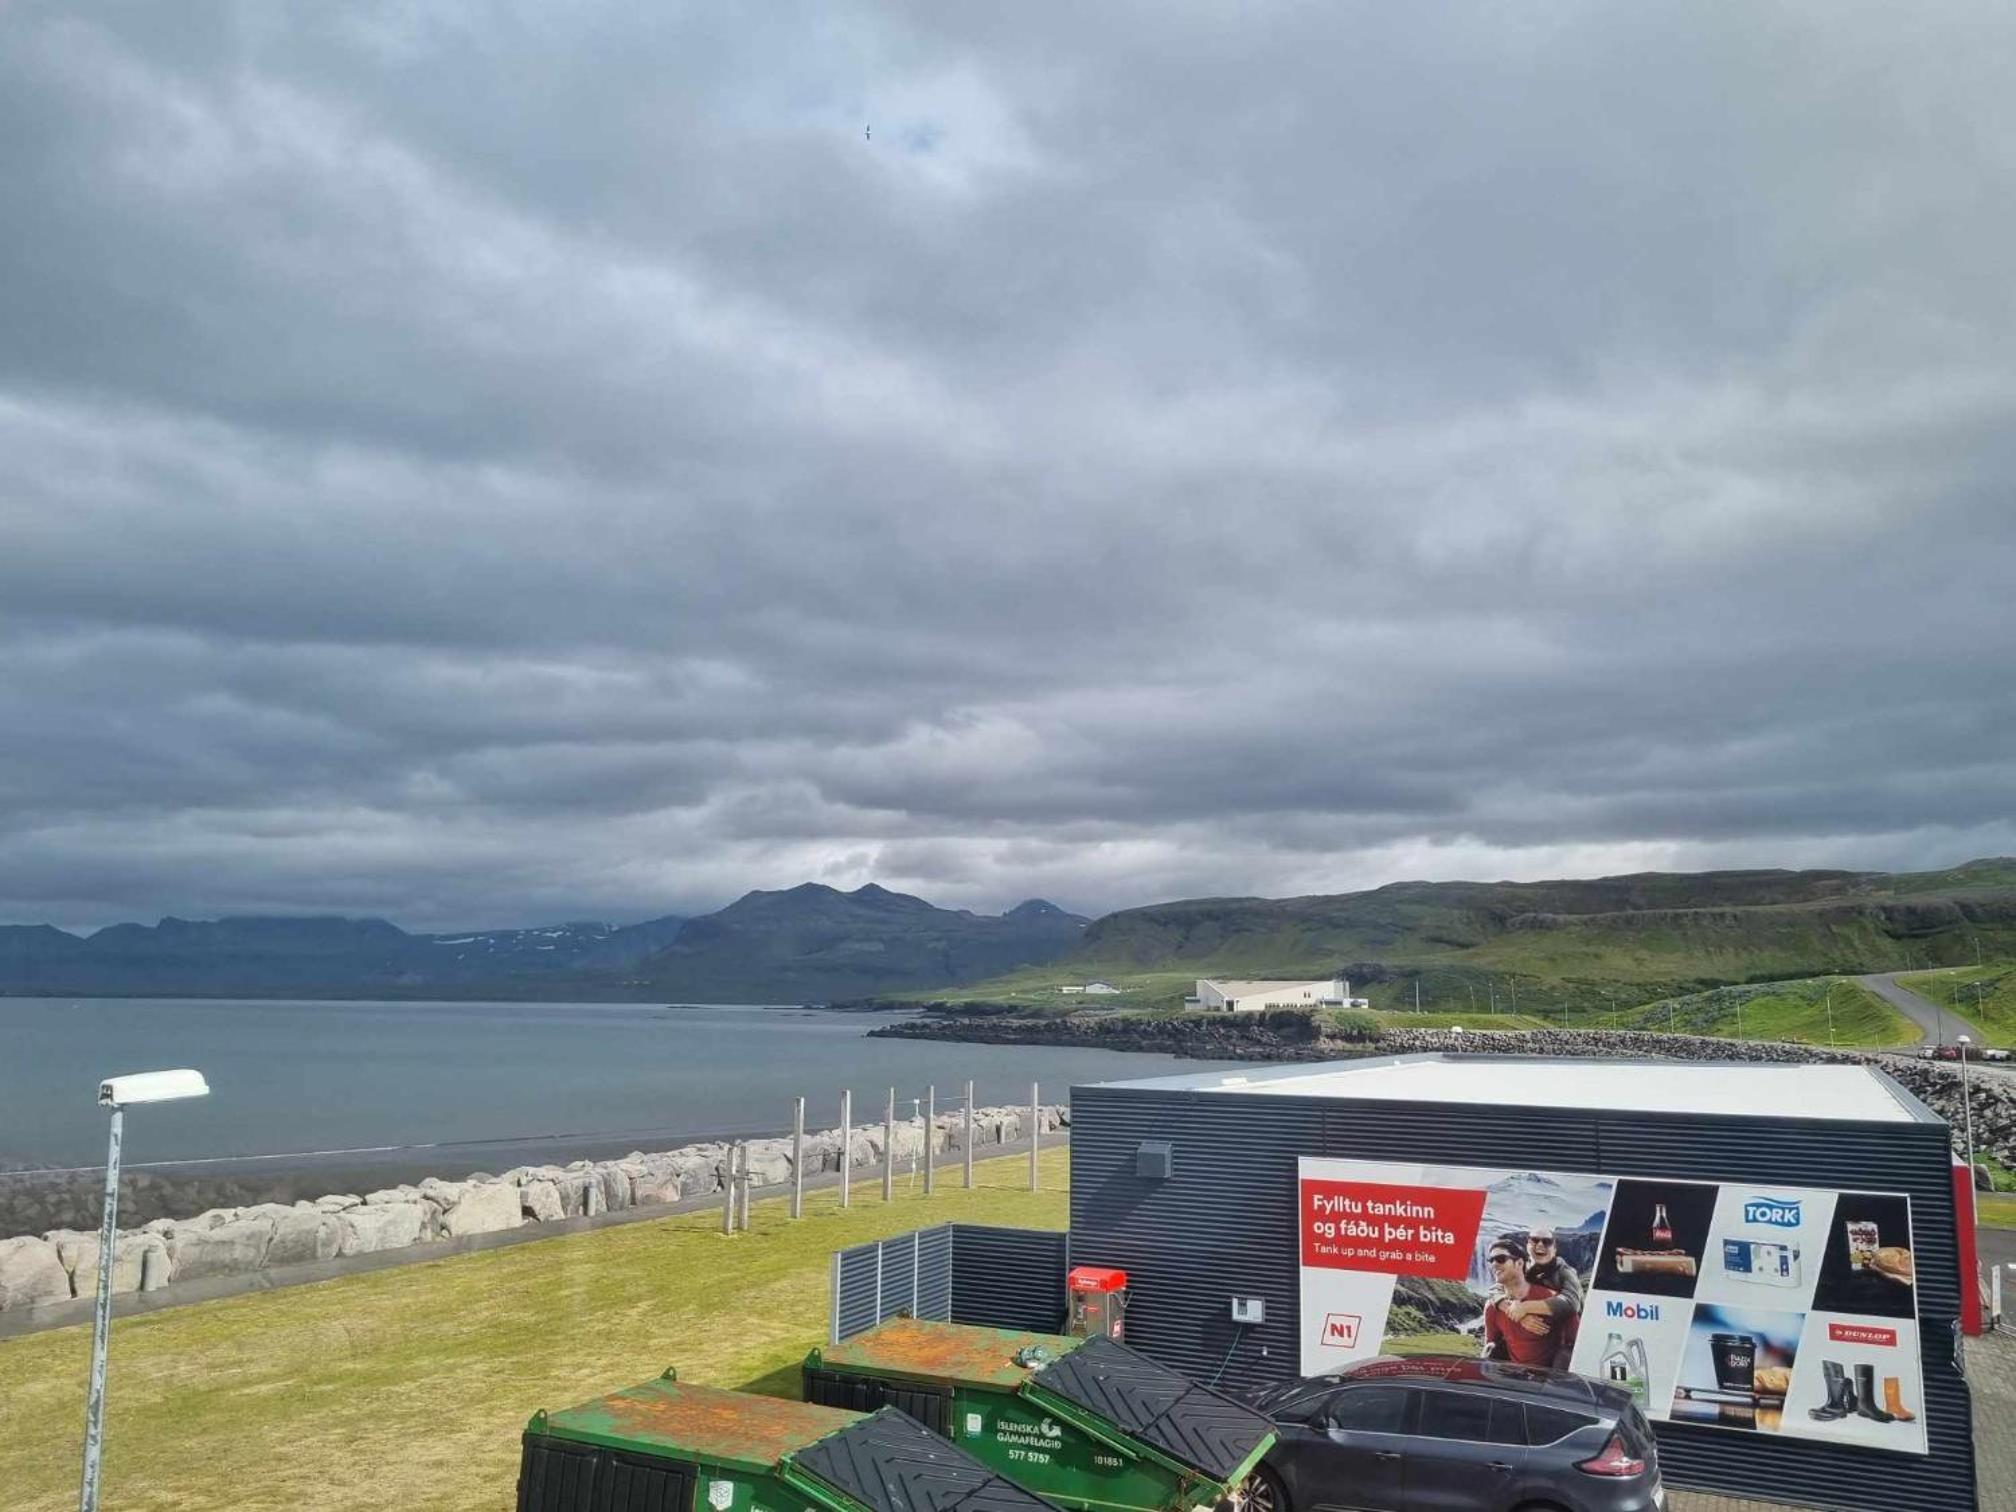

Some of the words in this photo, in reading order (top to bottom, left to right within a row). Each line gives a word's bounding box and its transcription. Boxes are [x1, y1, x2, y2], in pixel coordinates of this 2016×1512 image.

[1313, 1195, 1362, 1215] Fylltu
[1366, 1199, 1435, 1219] tankinn
[1746, 1206, 1798, 1224] TORK
[1313, 1222, 1335, 1238] og
[1340, 1219, 1379, 1238] fáðu
[1384, 1222, 1415, 1243] þér
[1419, 1225, 1455, 1244] bita
[1313, 1243, 1341, 1255] Tank
[1341, 1247, 1355, 1257] up
[1356, 1247, 1377, 1258] and
[1379, 1249, 1404, 1261] grab
[1405, 1252, 1412, 1260] a
[1414, 1250, 1436, 1263] bite
[1606, 1301, 1660, 1321] Mobil
[1330, 1322, 1352, 1339] N1
[1844, 1330, 1891, 1340] DUNLOP
[1009, 1449, 1025, 1460] 577
[1027, 1452, 1050, 1464] 5757
